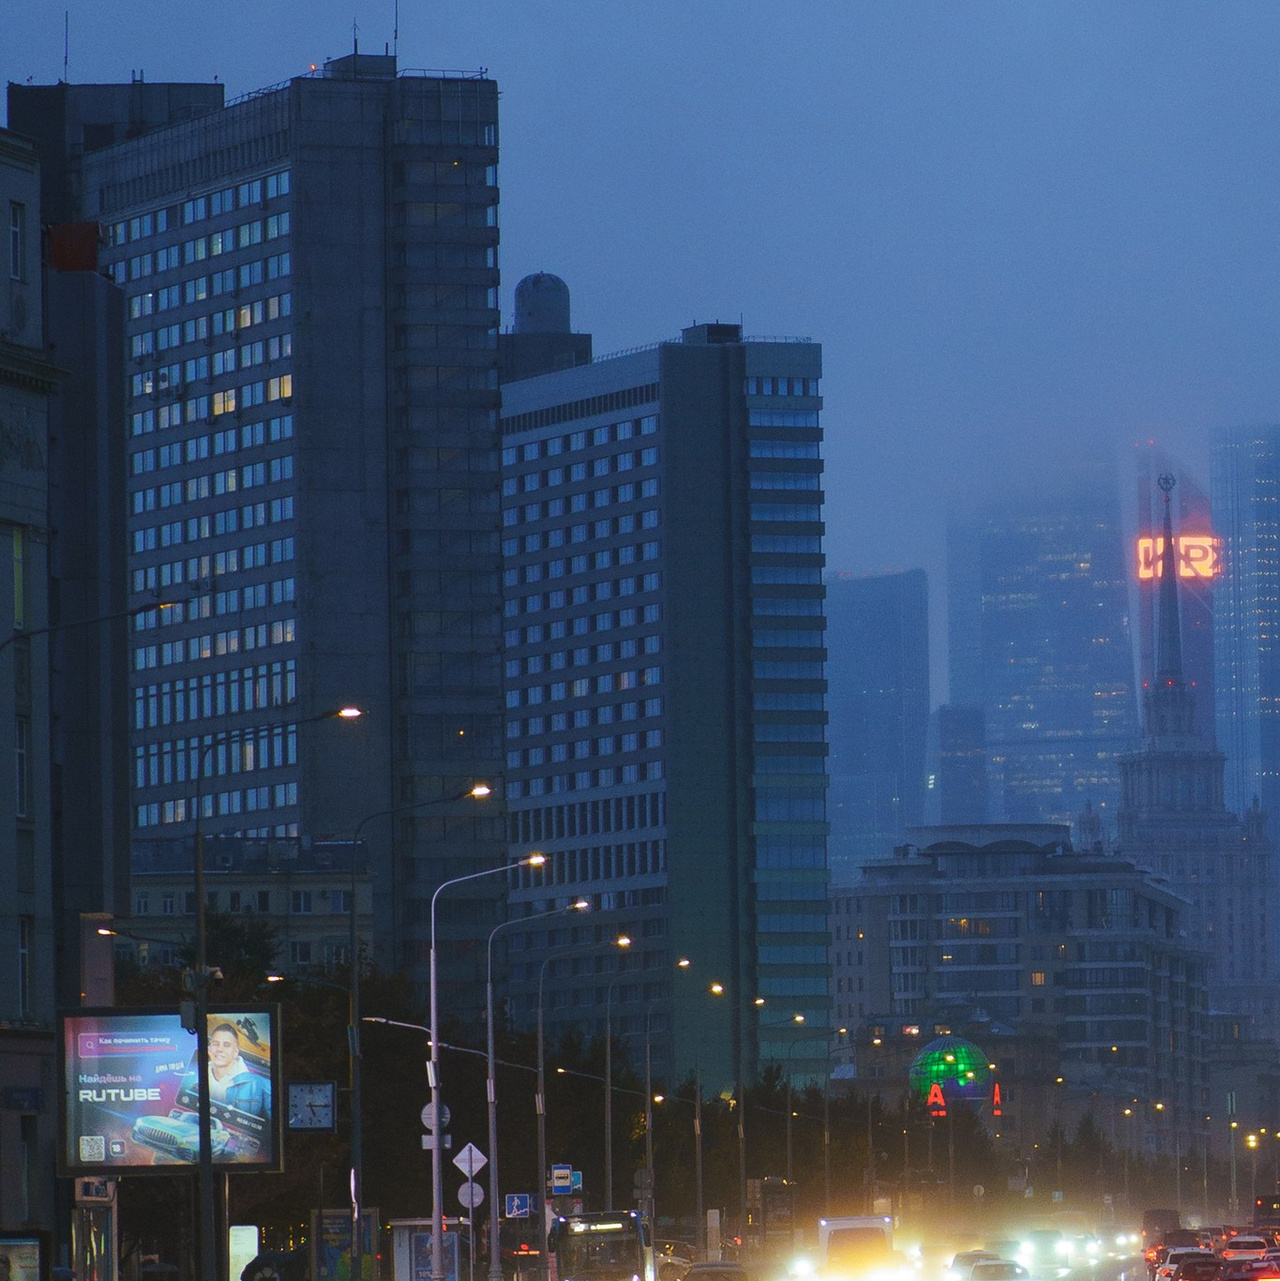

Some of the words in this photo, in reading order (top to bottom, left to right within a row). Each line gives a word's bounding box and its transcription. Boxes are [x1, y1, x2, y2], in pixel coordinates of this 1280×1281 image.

[99, 1037, 112, 1045] Как
[113, 1037, 149, 1045] починить
[150, 1036, 171, 1045] тачку
[79, 1073, 127, 1085] Найдёшь
[129, 1075, 142, 1083] на
[79, 1088, 161, 1103] RUTUBE
